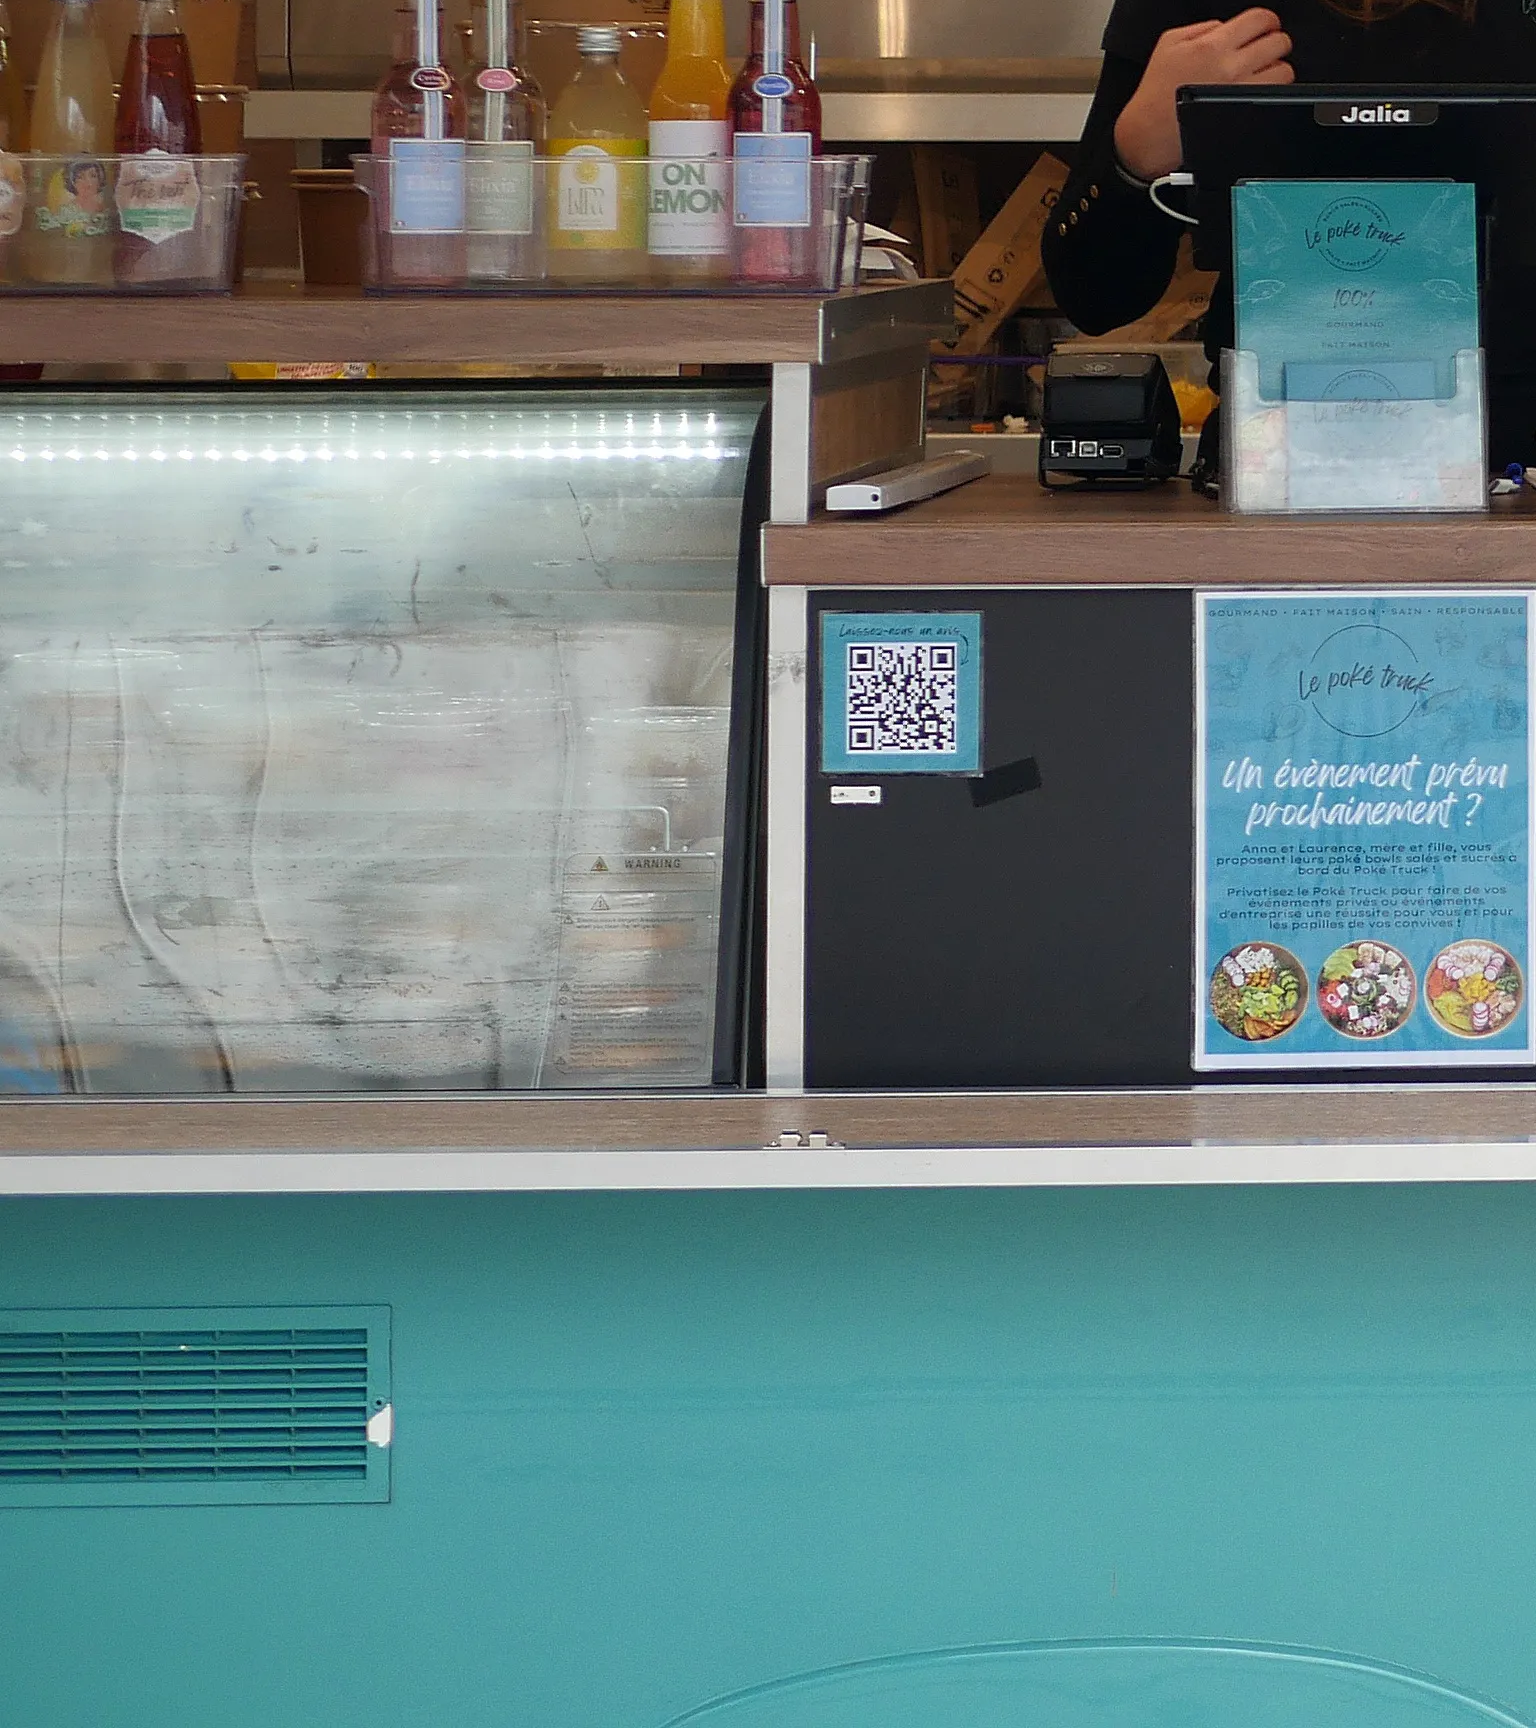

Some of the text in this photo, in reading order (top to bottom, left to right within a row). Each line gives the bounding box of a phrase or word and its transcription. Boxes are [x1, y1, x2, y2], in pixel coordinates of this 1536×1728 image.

[1341, 104, 1411, 124] Jalia
[662, 163, 705, 185] ON
[1299, 662, 1435, 701] Le poké truck
[1222, 757, 1262, 793] Un
[1425, 756, 1509, 796] prévu
[1245, 792, 1459, 834] prochainement
[625, 859, 681, 869] WARNING
